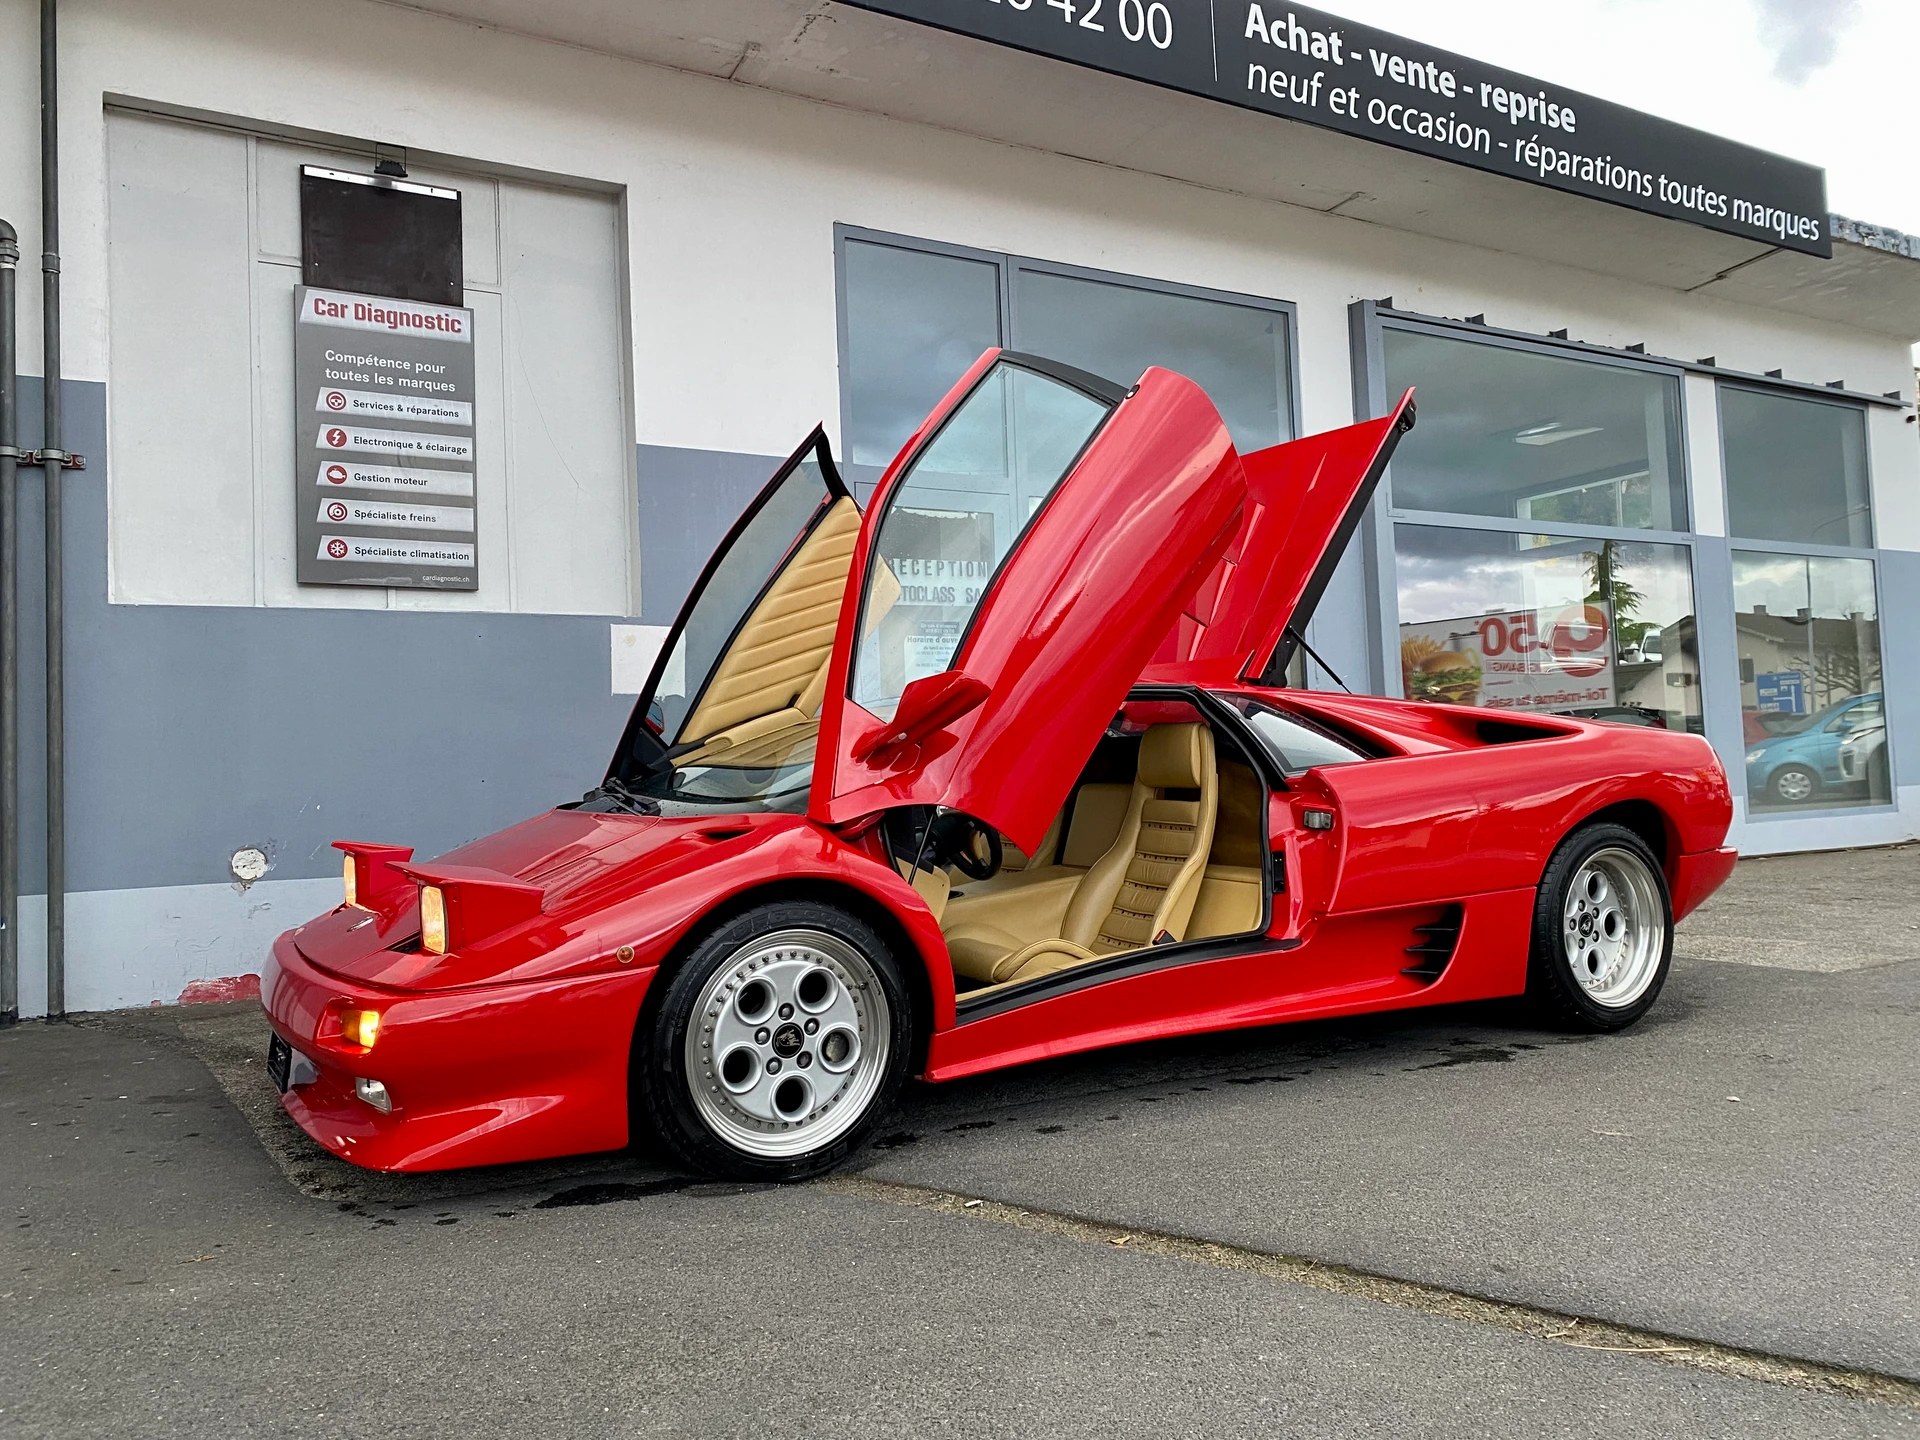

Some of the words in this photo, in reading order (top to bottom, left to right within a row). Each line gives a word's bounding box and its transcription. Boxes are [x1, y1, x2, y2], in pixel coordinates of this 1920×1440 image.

[1118, 0, 1173, 50] 00
[1244, 2, 1344, 66] Achat
[1368, 48, 1456, 99] vente
[1479, 81, 1577, 134] reprise
[1247, 63, 1325, 107] neuf
[1329, 86, 1360, 119] et
[1367, 95, 1491, 154] occasion
[1515, 134, 1653, 197] réparations
[1658, 174, 1728, 217] toutes
[1732, 198, 1820, 241] marques
[314, 298, 348, 318] Car
[354, 303, 462, 333] Diagnostic
[325, 350, 411, 370] Compétence
[415, 362, 446, 374] pour
[325, 368, 370, 383] toutes
[374, 373, 394, 385] les
[398, 377, 456, 392] marques
[353, 399, 394, 411] Services
[397, 404, 404, 412] &
[406, 405, 460, 418] réparations
[353, 436, 414, 449] Electronique
[416, 442, 423, 450] &
[425, 443, 468, 455] éclairage
[354, 473, 391, 483] Gestion
[394, 477, 428, 486] moteur
[354, 509, 407, 521] Spécialiste
[409, 513, 437, 523] freins
[354, 546, 407, 557] Spécialiste
[409, 549, 470, 560] climatisation
[899, 585, 955, 603] TOCLASS
